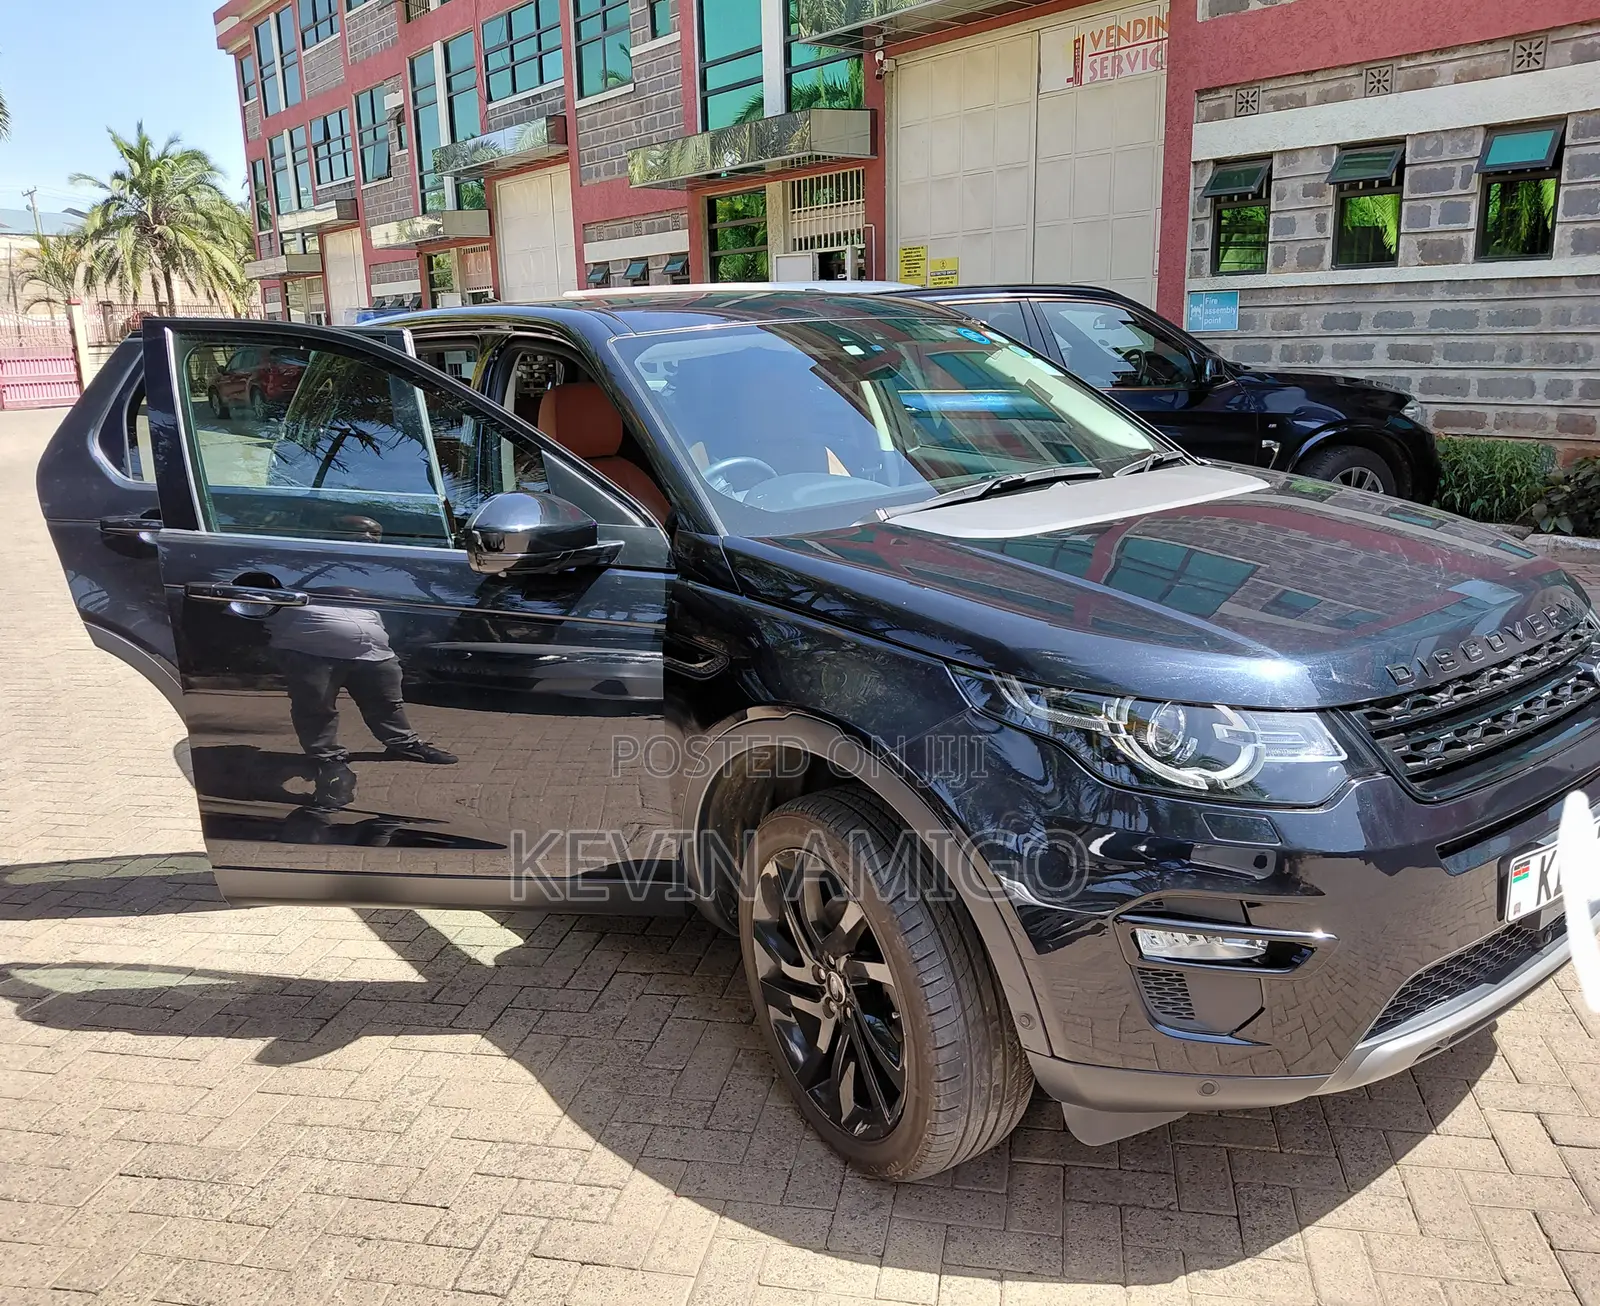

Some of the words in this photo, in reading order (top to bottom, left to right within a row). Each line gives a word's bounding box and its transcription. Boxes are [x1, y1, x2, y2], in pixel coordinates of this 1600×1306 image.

[1205, 296, 1219, 305] Fire
[1204, 306, 1236, 315] assembly
[1203, 317, 1221, 327] point
[1385, 597, 1573, 687] DISCOVERY
